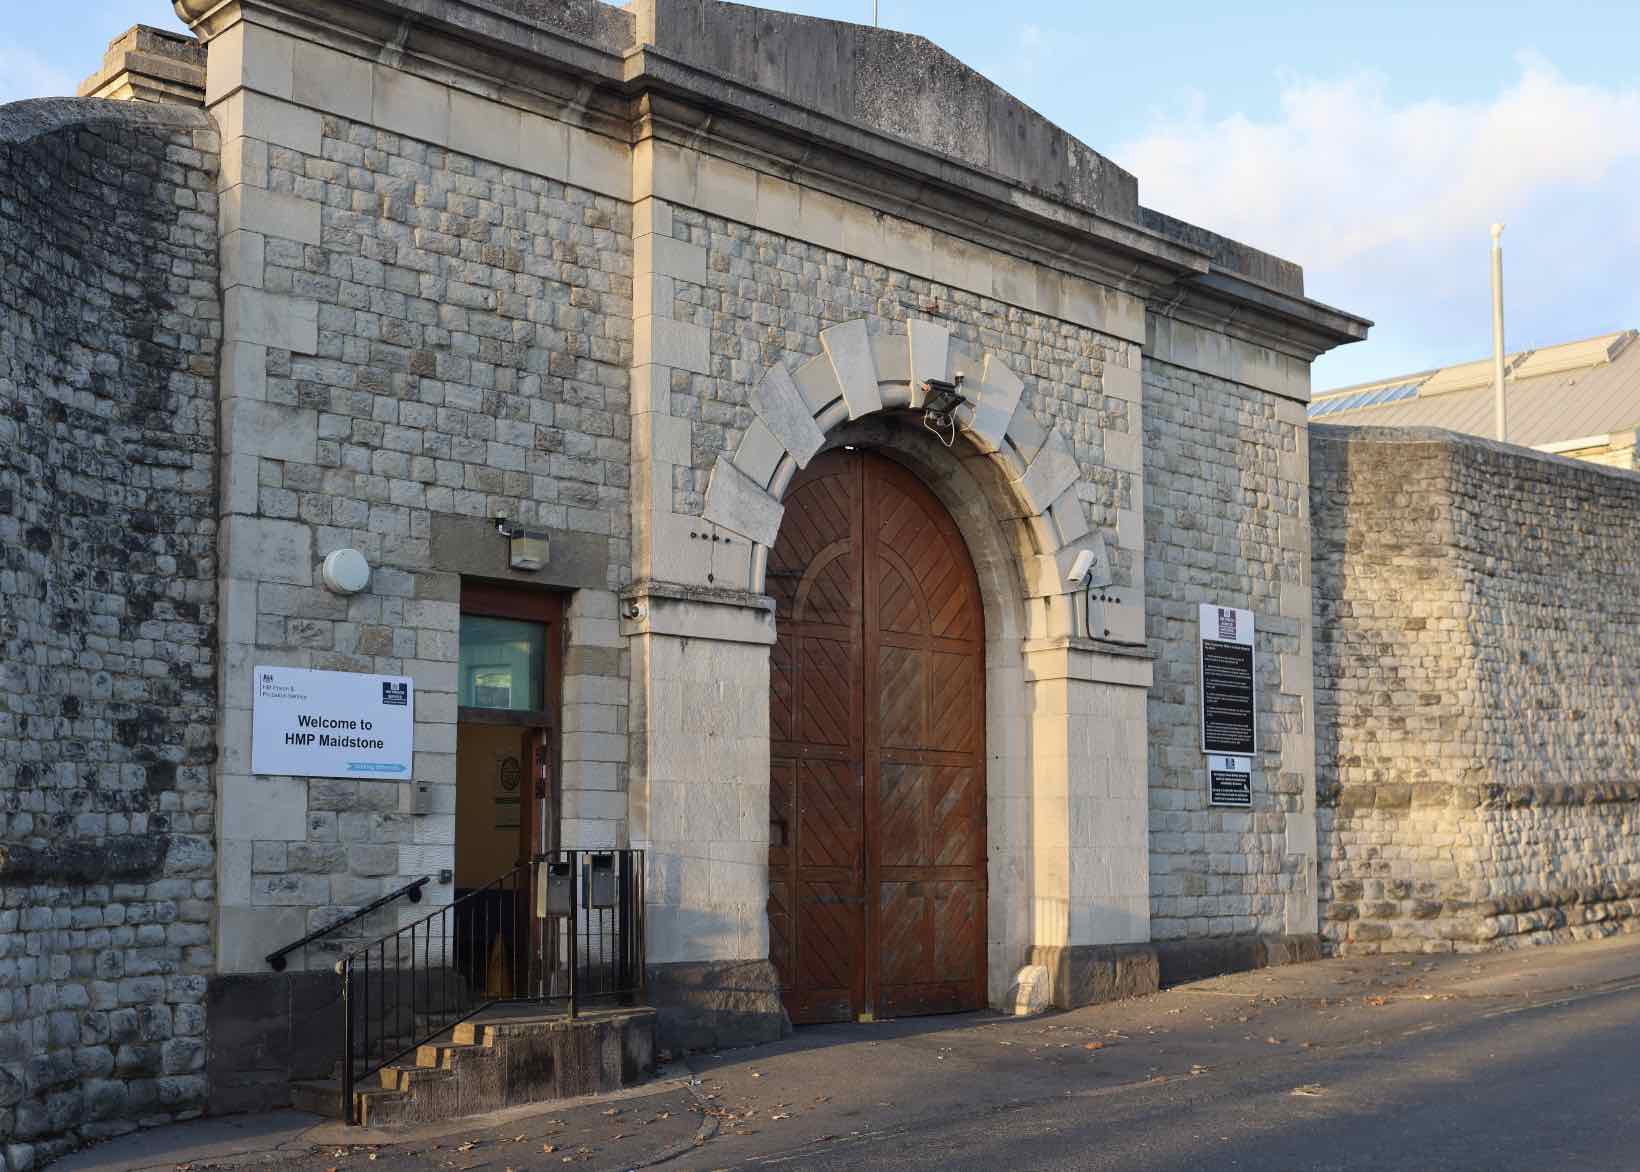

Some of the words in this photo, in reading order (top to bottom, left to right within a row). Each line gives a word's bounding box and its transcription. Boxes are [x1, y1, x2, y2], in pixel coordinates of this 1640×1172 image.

[298, 715, 357, 730] Welcome
[361, 719, 373, 731] to
[285, 733, 316, 746] HMP
[319, 735, 384, 749] Maidstone
